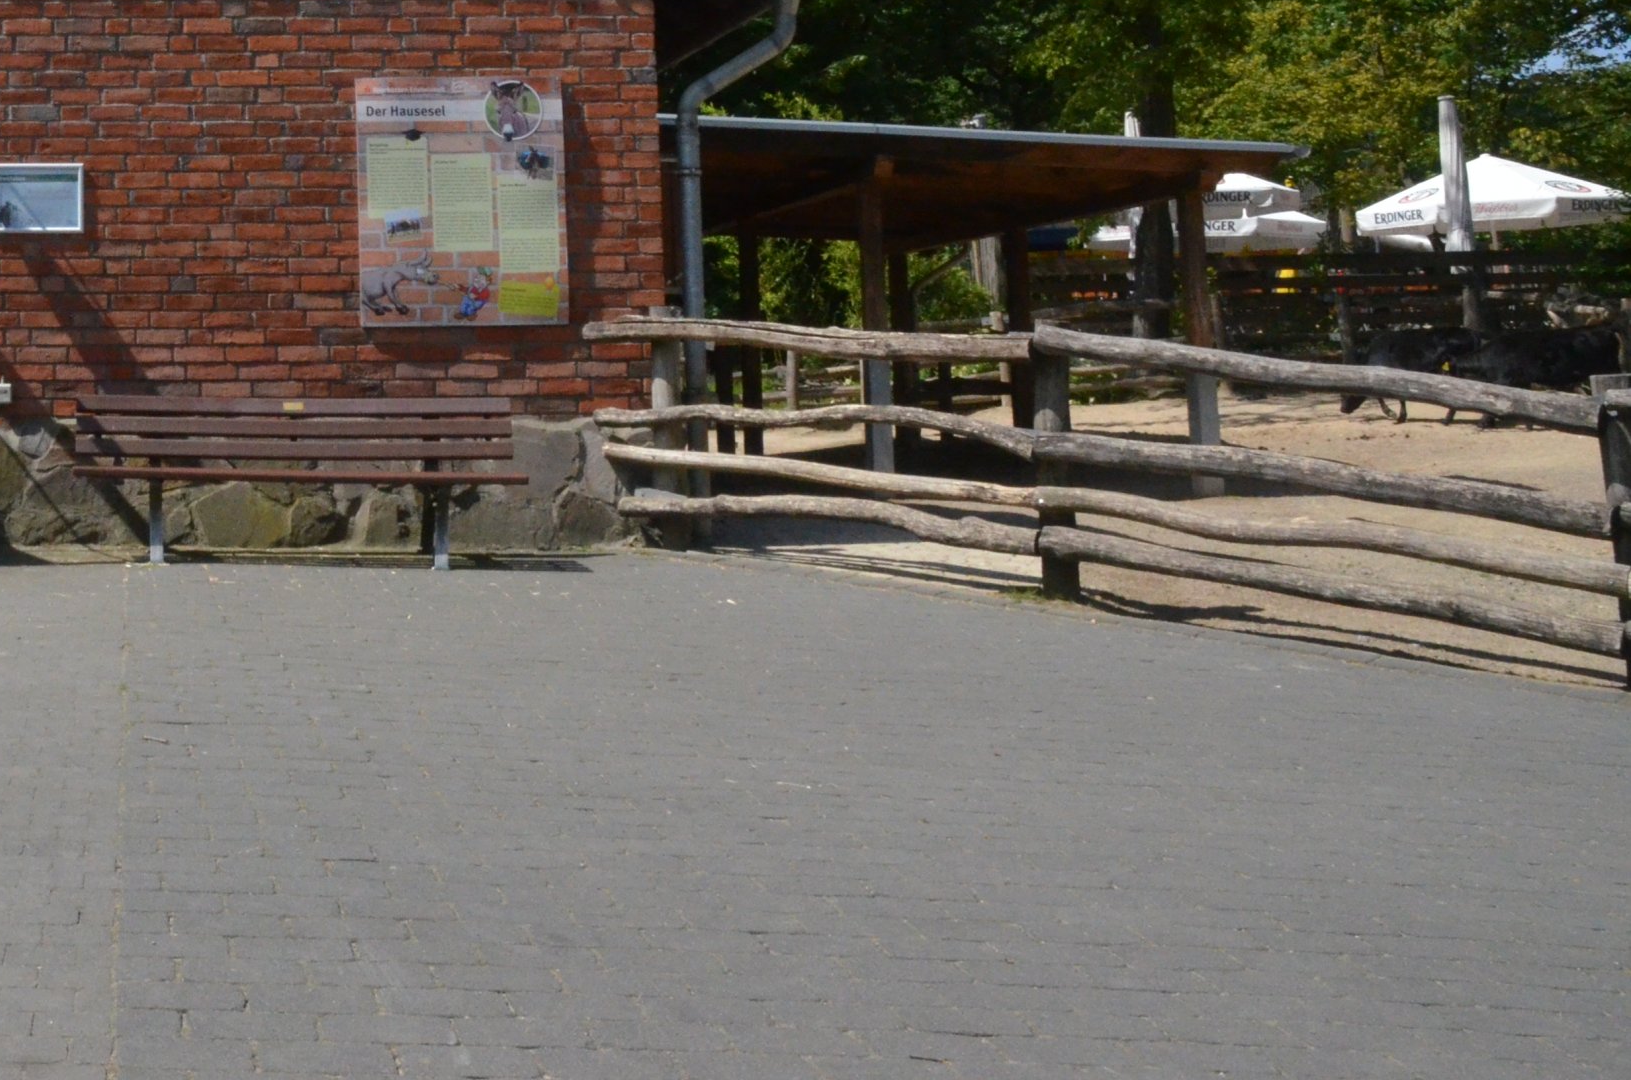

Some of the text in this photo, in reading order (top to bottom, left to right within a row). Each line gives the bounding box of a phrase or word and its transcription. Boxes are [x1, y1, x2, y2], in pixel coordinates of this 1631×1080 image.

[366, 105, 446, 117] Der Hausesel
[1374, 209, 1425, 225] ERDINGER
